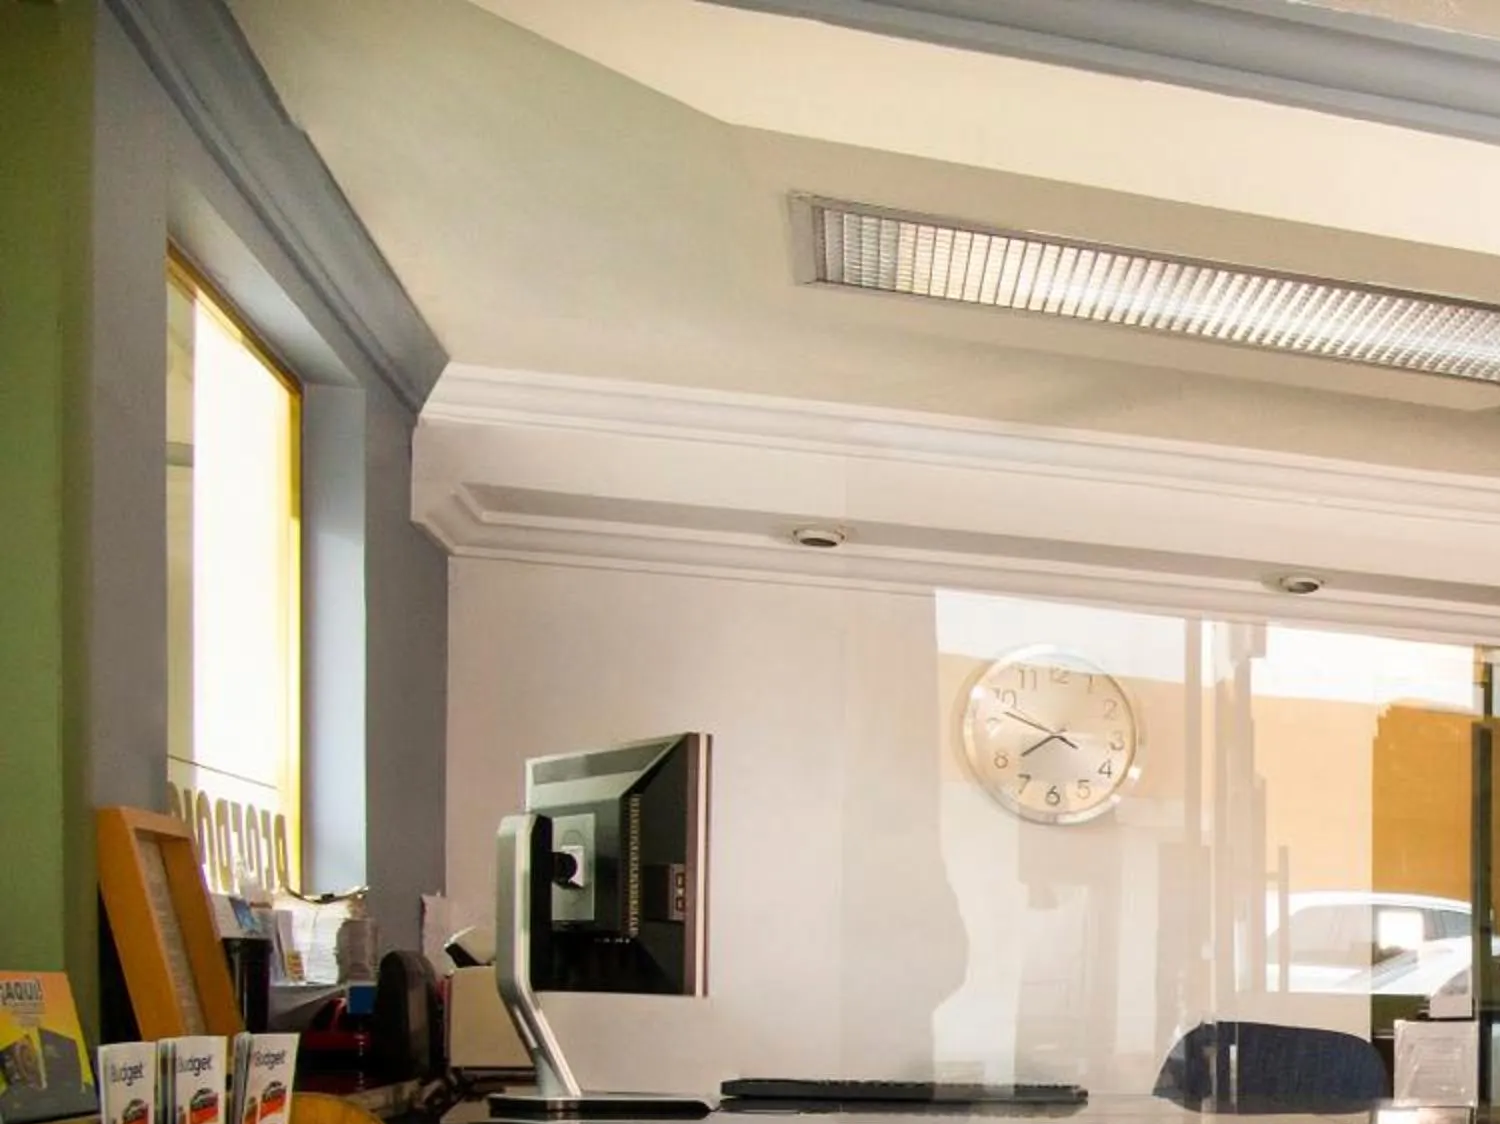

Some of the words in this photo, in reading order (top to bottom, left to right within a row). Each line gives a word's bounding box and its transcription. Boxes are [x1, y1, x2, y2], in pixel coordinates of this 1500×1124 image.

[1097, 759, 1113, 779] 4
[1016, 773, 1032, 795] 7
[1044, 785, 1061, 807] 6
[177, 1053, 213, 1077] Budget
[254, 1049, 287, 1071] Budget
[109, 1061, 146, 1087] Budget
